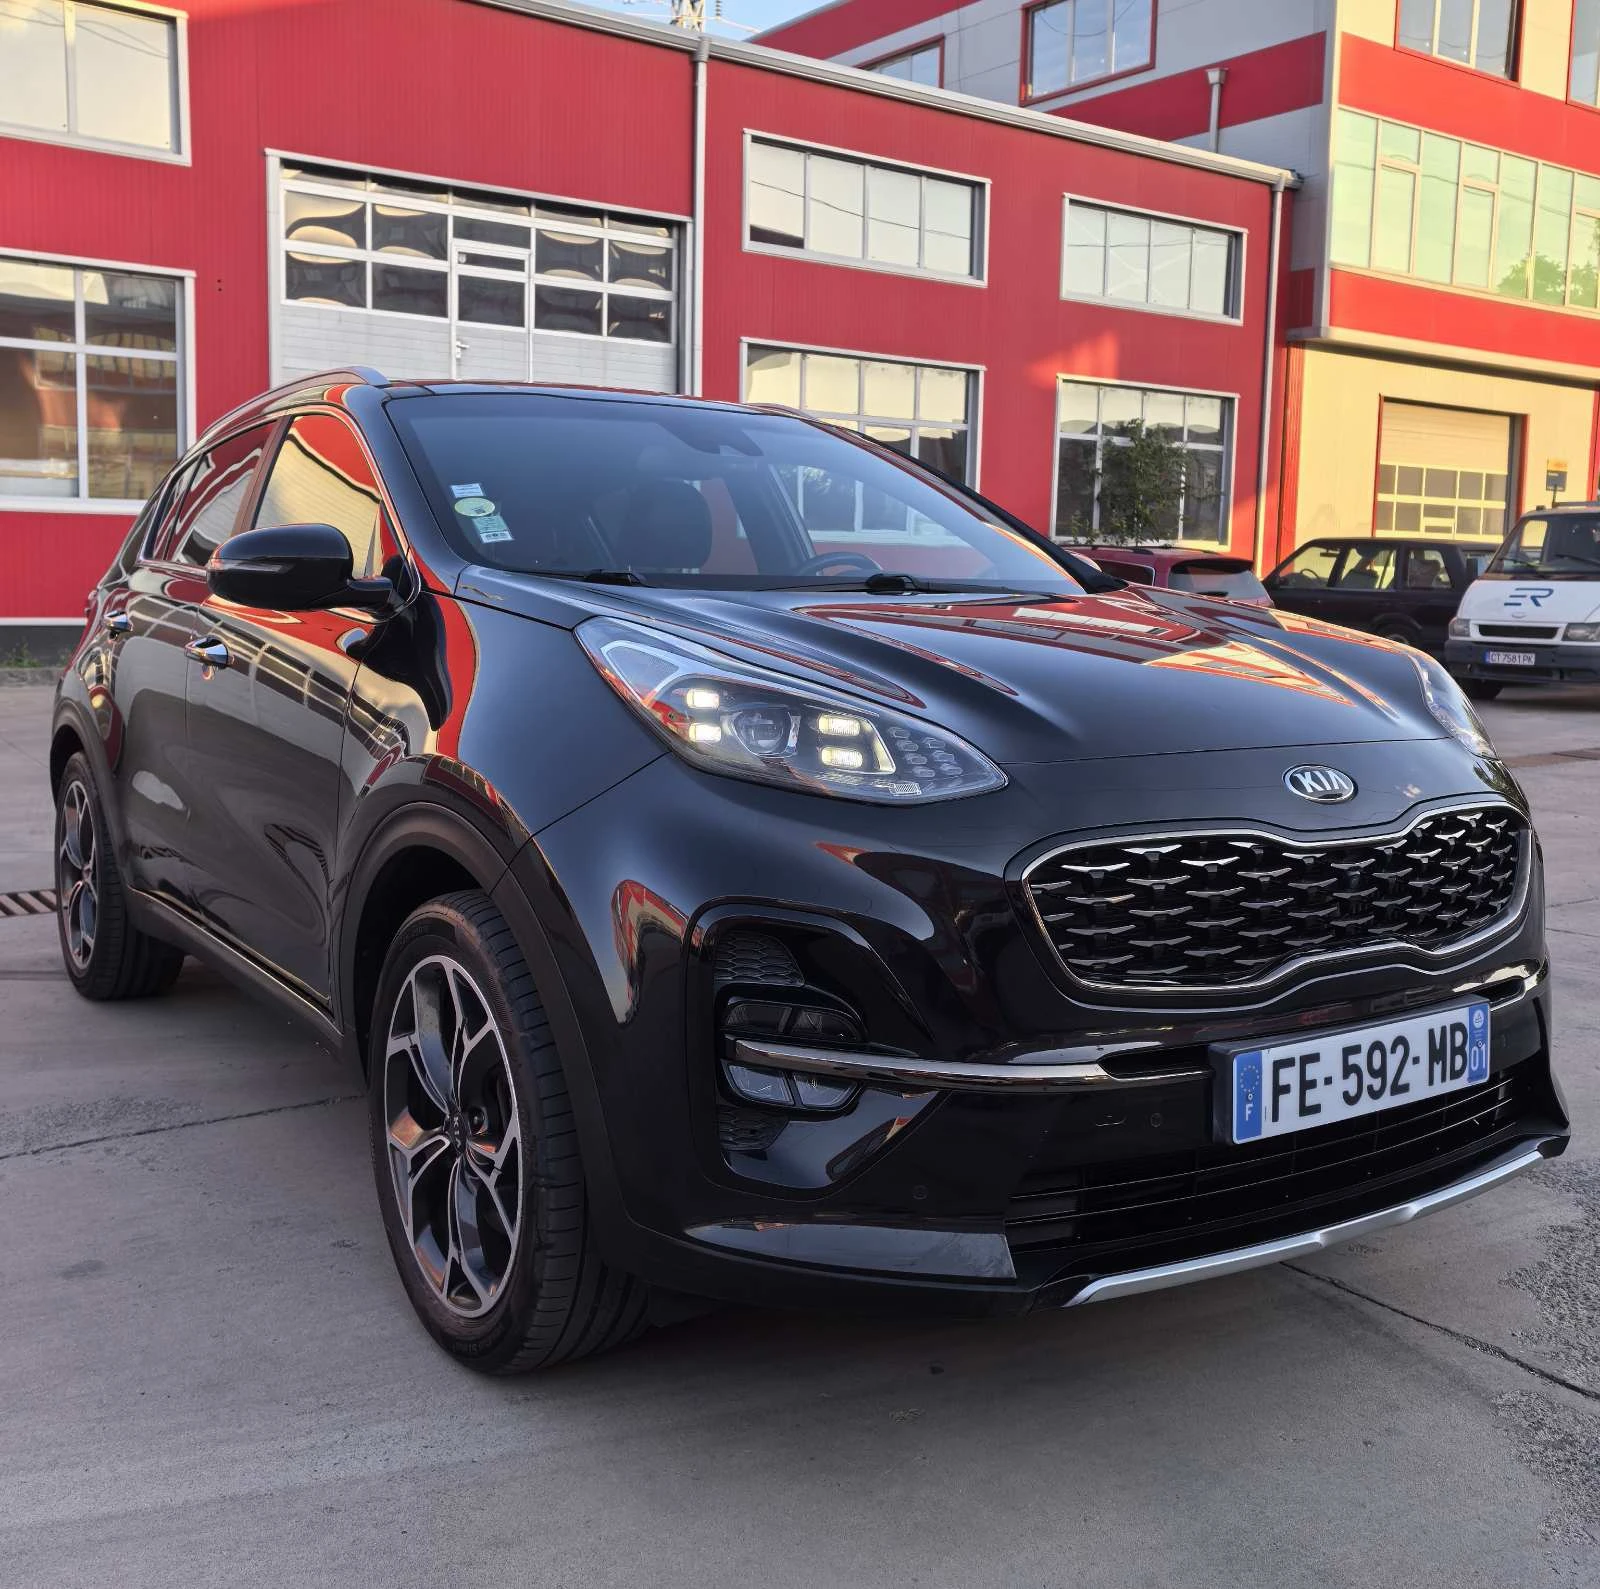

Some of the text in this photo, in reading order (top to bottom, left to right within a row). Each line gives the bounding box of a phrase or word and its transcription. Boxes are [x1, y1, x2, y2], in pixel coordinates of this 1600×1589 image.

[1294, 770, 1349, 793] KIA
[1470, 1043, 1487, 1071] 01
[1271, 1022, 1469, 1123] FE-592-MB
[1245, 1103, 1254, 1121] F
